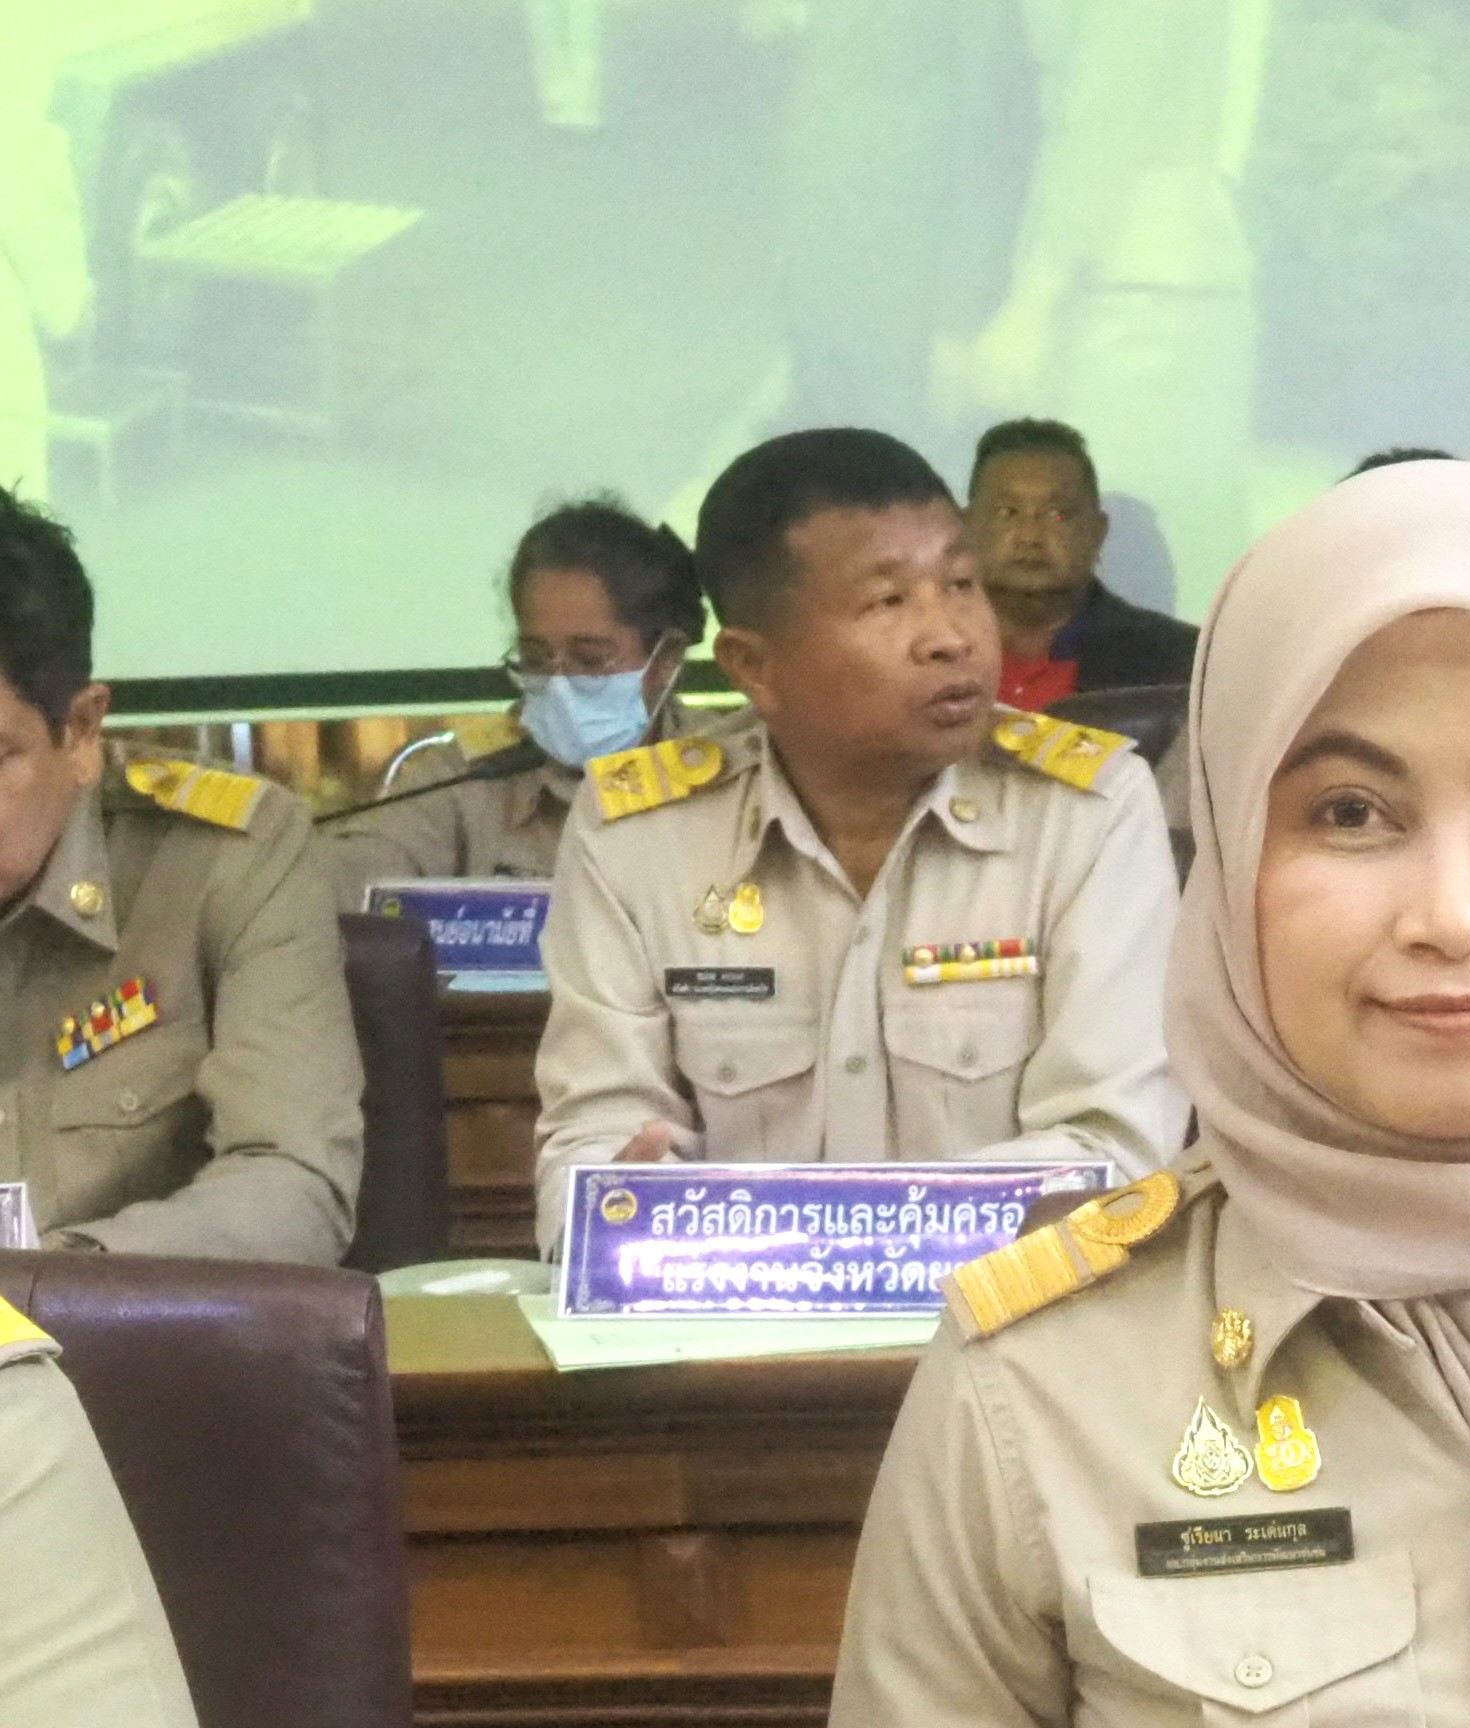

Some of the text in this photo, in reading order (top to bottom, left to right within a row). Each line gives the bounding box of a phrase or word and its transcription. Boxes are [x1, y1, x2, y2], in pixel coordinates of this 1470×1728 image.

[650, 1186, 1025, 1247] สวัสดิการและคุ้มครอ
